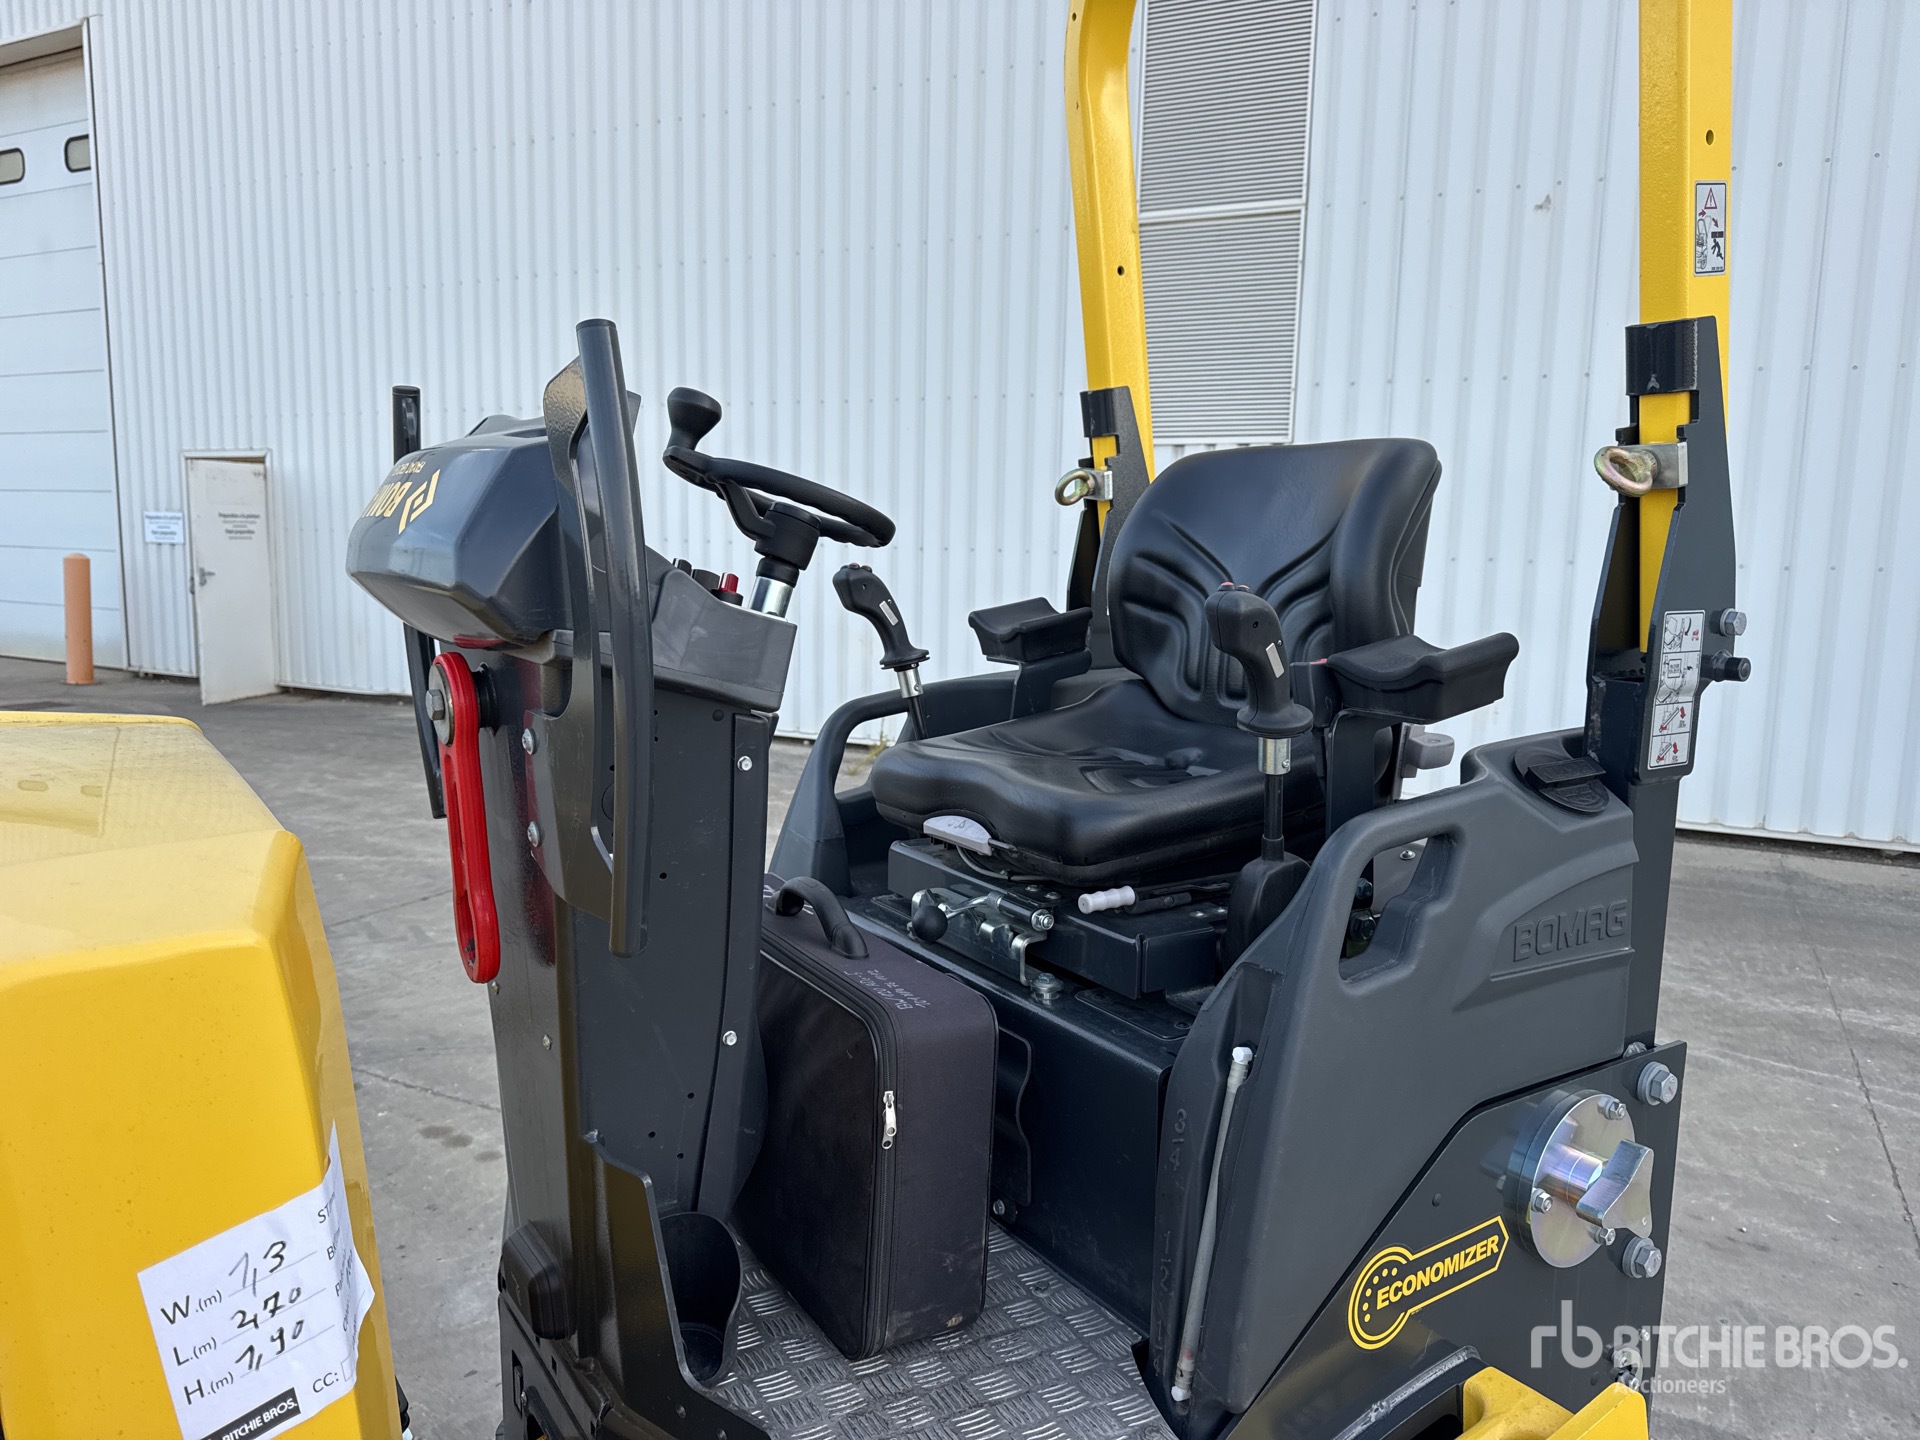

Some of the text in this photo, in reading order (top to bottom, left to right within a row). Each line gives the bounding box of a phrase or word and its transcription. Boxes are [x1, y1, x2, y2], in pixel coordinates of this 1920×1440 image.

[1513, 899, 1628, 963] BOMAG
[1376, 1234, 1500, 1310] ECONOMIZER
[312, 1370, 339, 1394] CC:
[263, 1397, 298, 1423] BROS.
